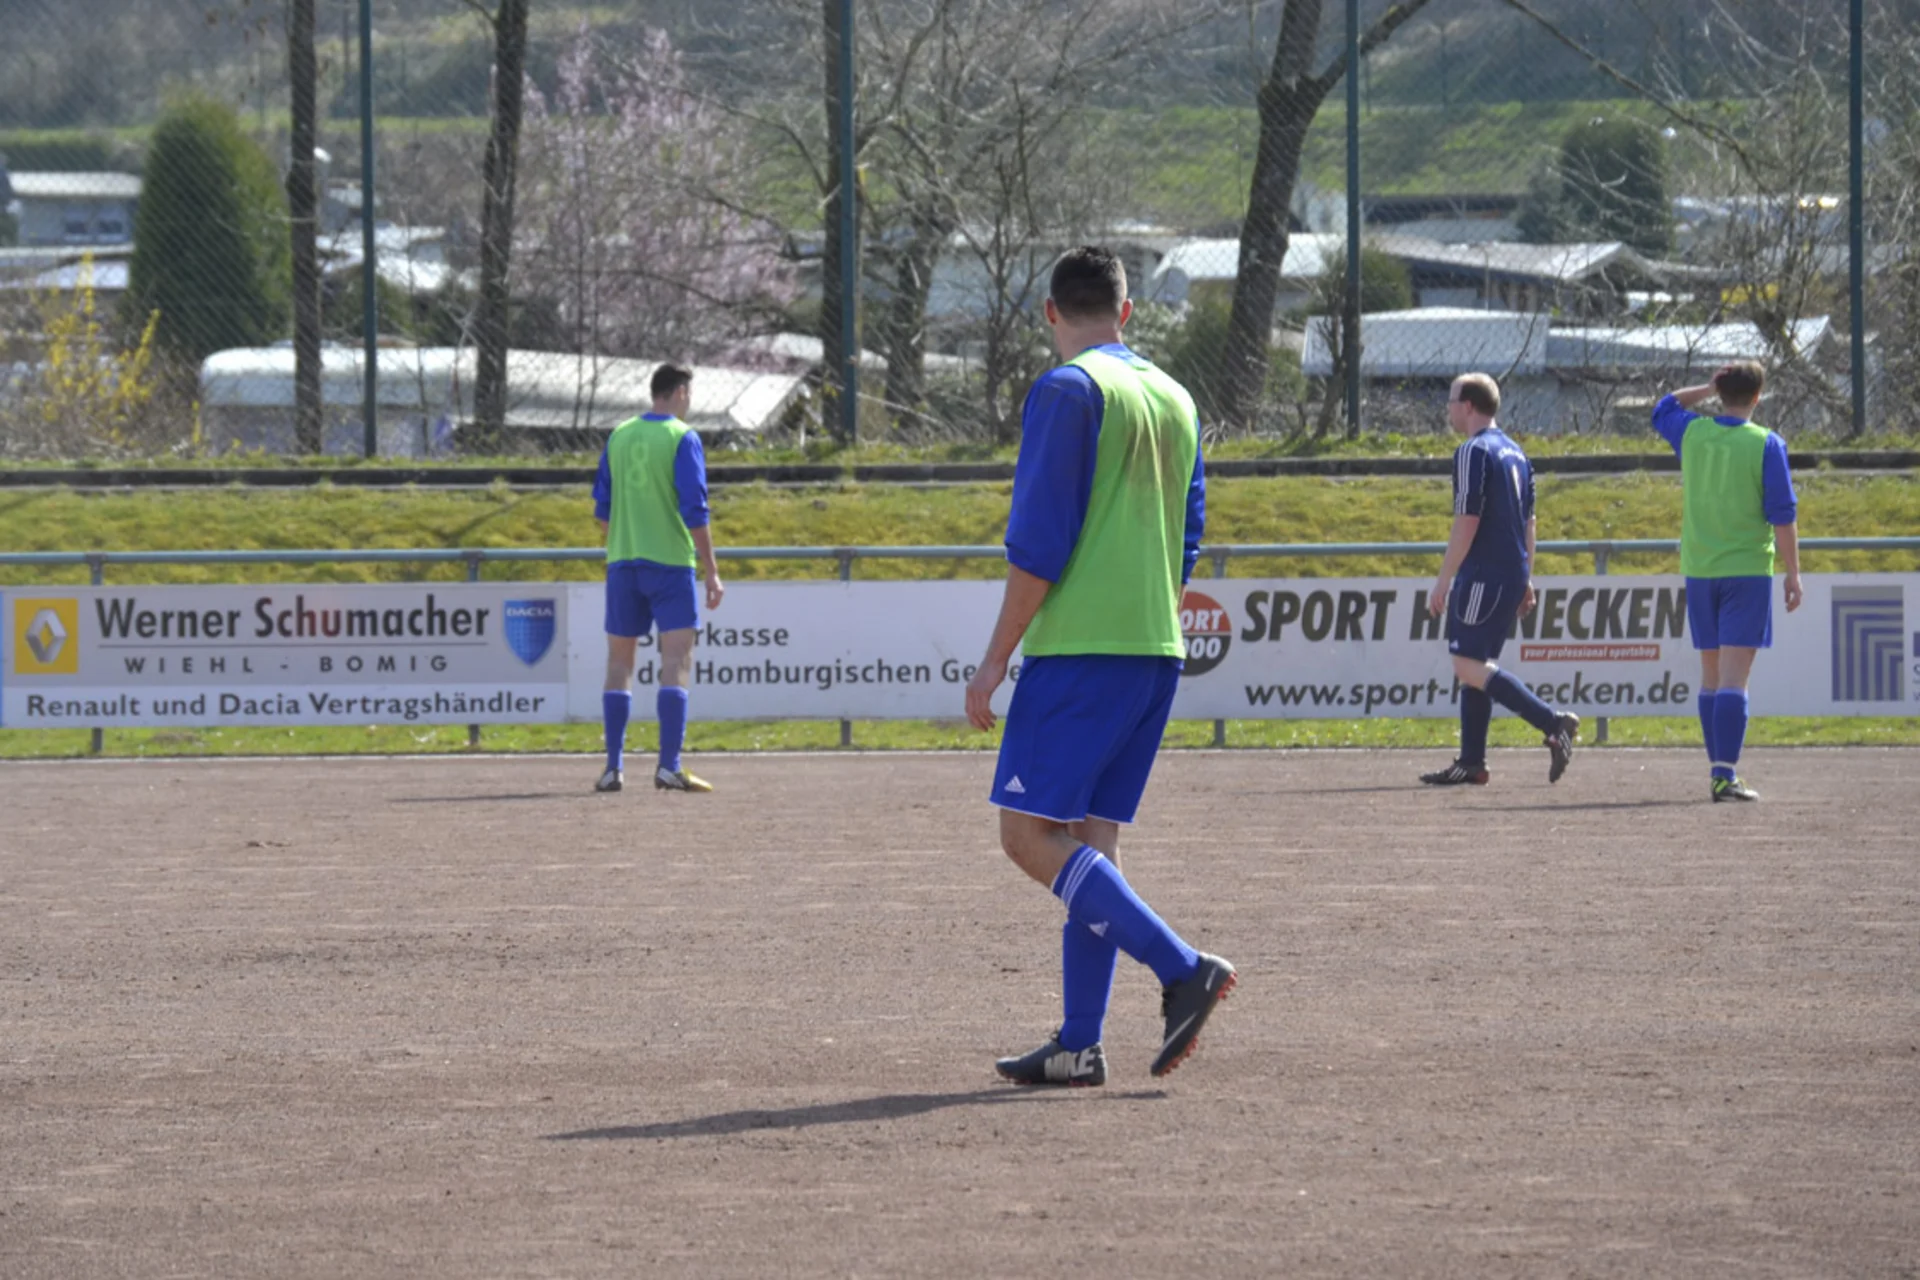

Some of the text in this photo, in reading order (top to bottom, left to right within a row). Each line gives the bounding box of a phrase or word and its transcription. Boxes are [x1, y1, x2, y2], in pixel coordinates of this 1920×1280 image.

[95, 593, 490, 639] Werner Schumacher
[506, 606, 554, 617] DACIA
[1180, 609, 1224, 631] ORT
[1241, 587, 1688, 642] SPORT HNECKEN
[124, 656, 255, 674] WIEHL
[319, 655, 448, 673] BOMIG
[695, 658, 931, 691] Homburgischen
[27, 690, 546, 721] Renault und Dacia Vertragshändler
